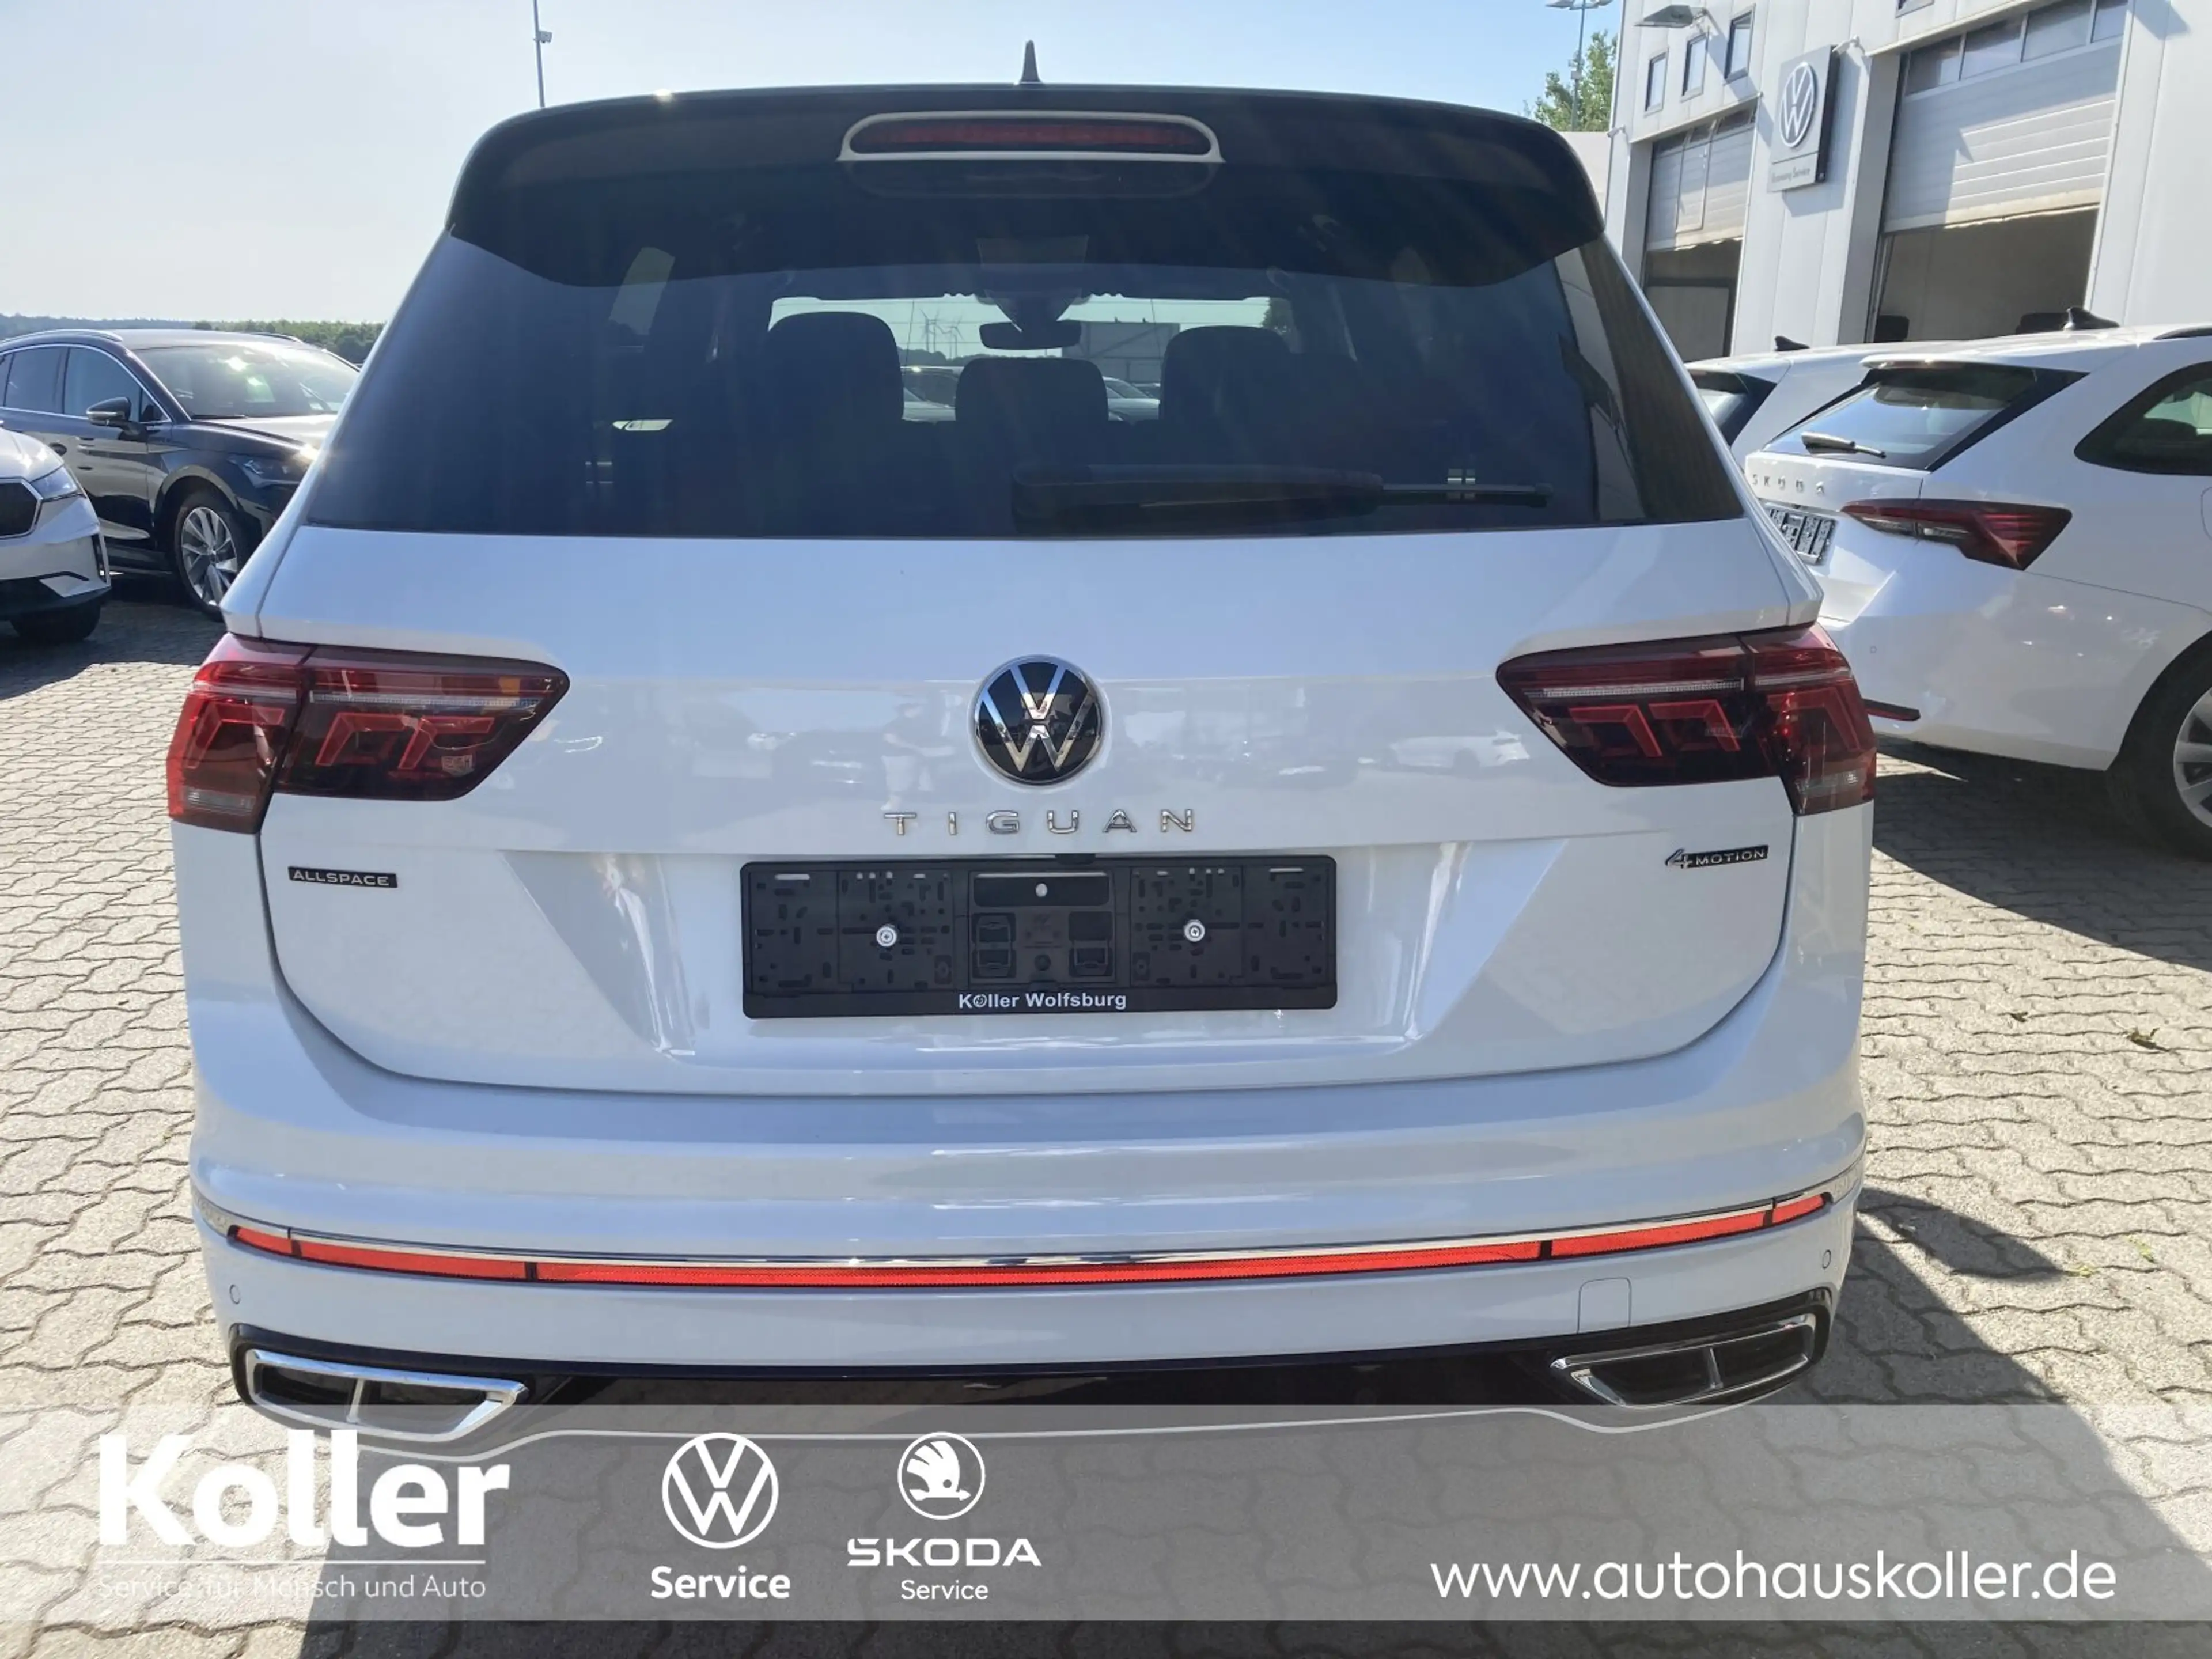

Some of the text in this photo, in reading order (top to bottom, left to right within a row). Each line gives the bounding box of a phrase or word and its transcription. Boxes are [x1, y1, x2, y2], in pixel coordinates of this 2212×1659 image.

[883, 809, 1194, 836] TIGUAN
[1665, 848, 1766, 869] 4MOTION
[293, 869, 389, 886] ALLSPACE
[959, 992, 1127, 1010] Koller Wolfsburg
